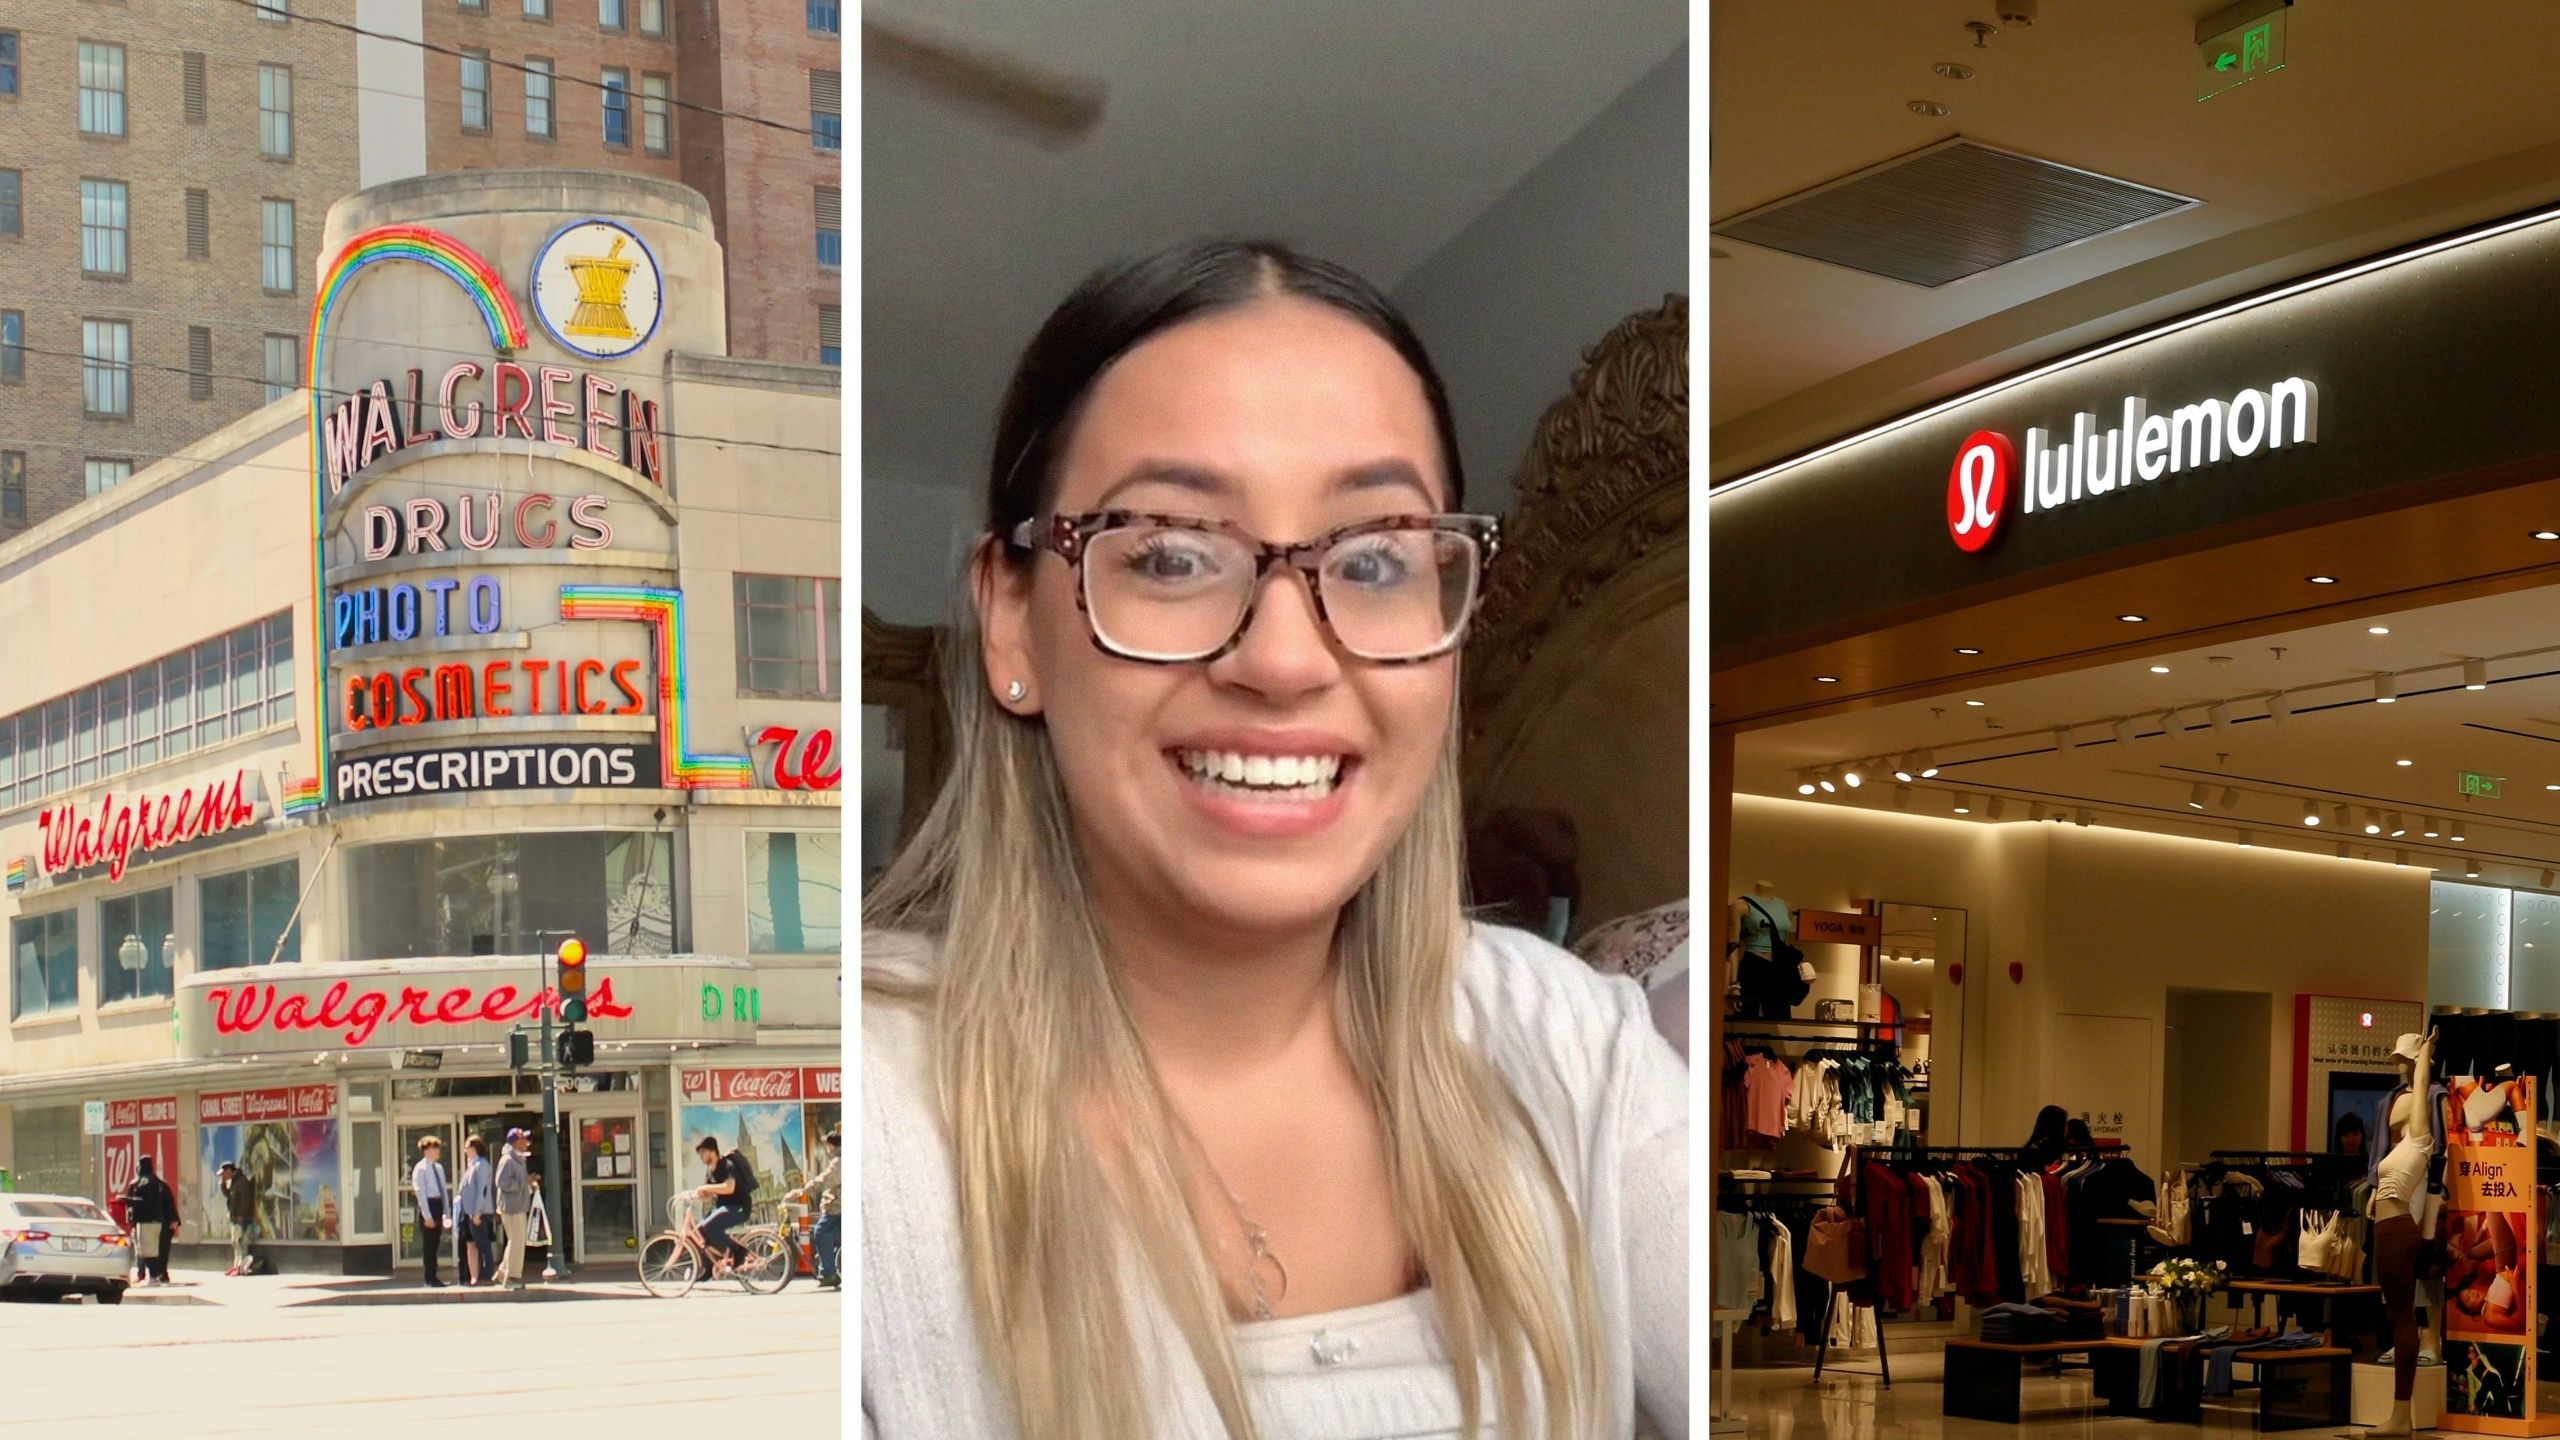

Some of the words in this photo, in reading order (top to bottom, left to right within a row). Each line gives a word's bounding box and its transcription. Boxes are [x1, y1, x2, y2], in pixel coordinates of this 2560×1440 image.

[324, 361, 661, 495] WALGREEN
[2024, 377, 2318, 514] lululemon
[365, 493, 613, 561] DRUGS
[333, 575, 500, 650] PHOTO
[344, 659, 645, 731] COSMETICS
[337, 748, 635, 801] PRESCRIPTIONS
[39, 768, 254, 883] Walgreens
[1813, 921, 1844, 934] YOGA
[2481, 1181, 2517, 1198] 去投入
